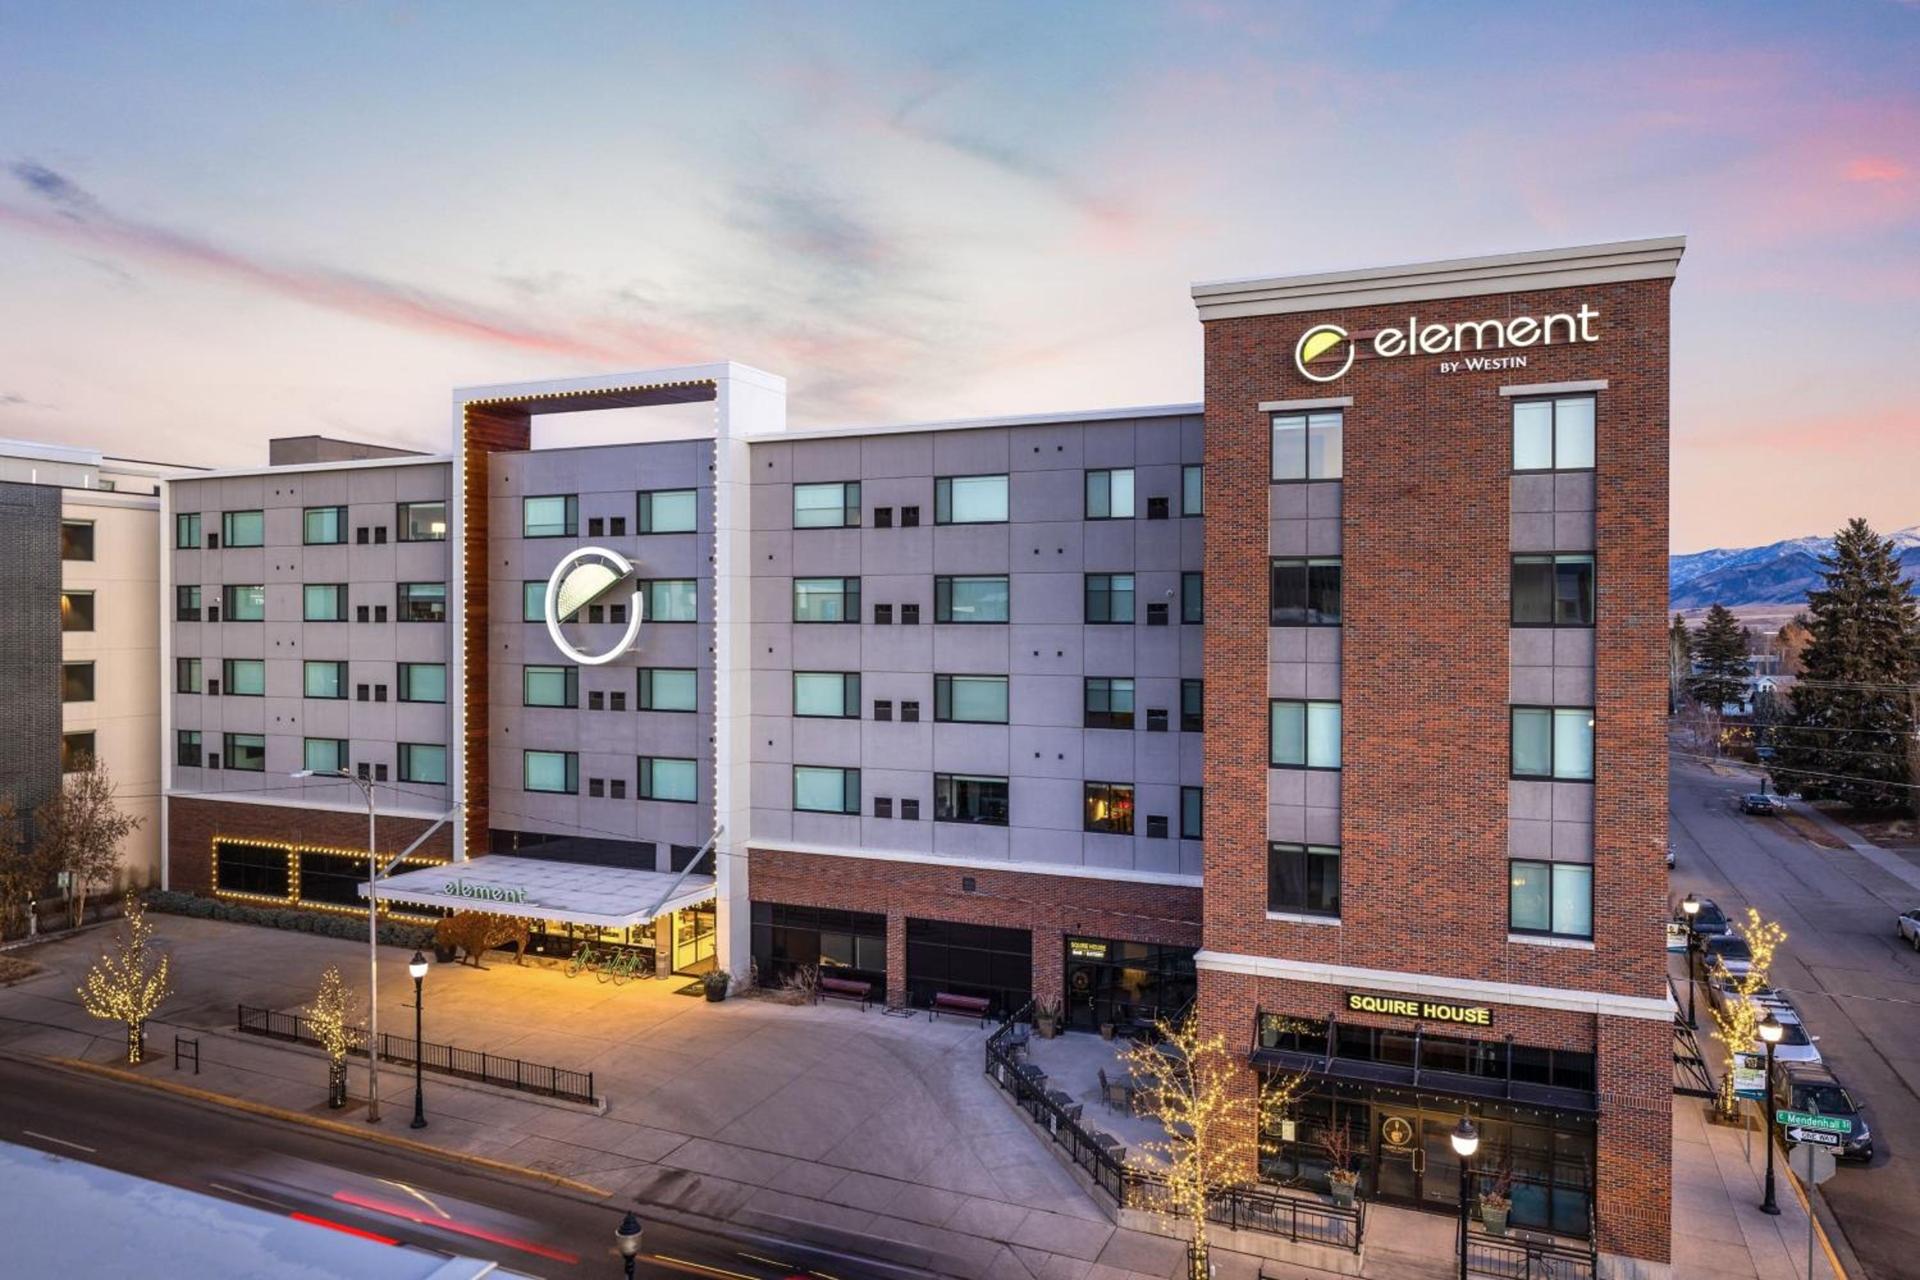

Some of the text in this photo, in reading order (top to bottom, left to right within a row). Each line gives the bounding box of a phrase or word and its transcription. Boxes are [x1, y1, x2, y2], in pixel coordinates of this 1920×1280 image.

[1374, 303, 1600, 357] element
[1440, 361, 1459, 374] BY
[444, 878, 528, 904] element
[1349, 995, 1490, 1025] SQUIRE HOUSE
[1787, 1114, 1840, 1129] Mendenhall
[1802, 1130, 1838, 1144] ONE WAY
